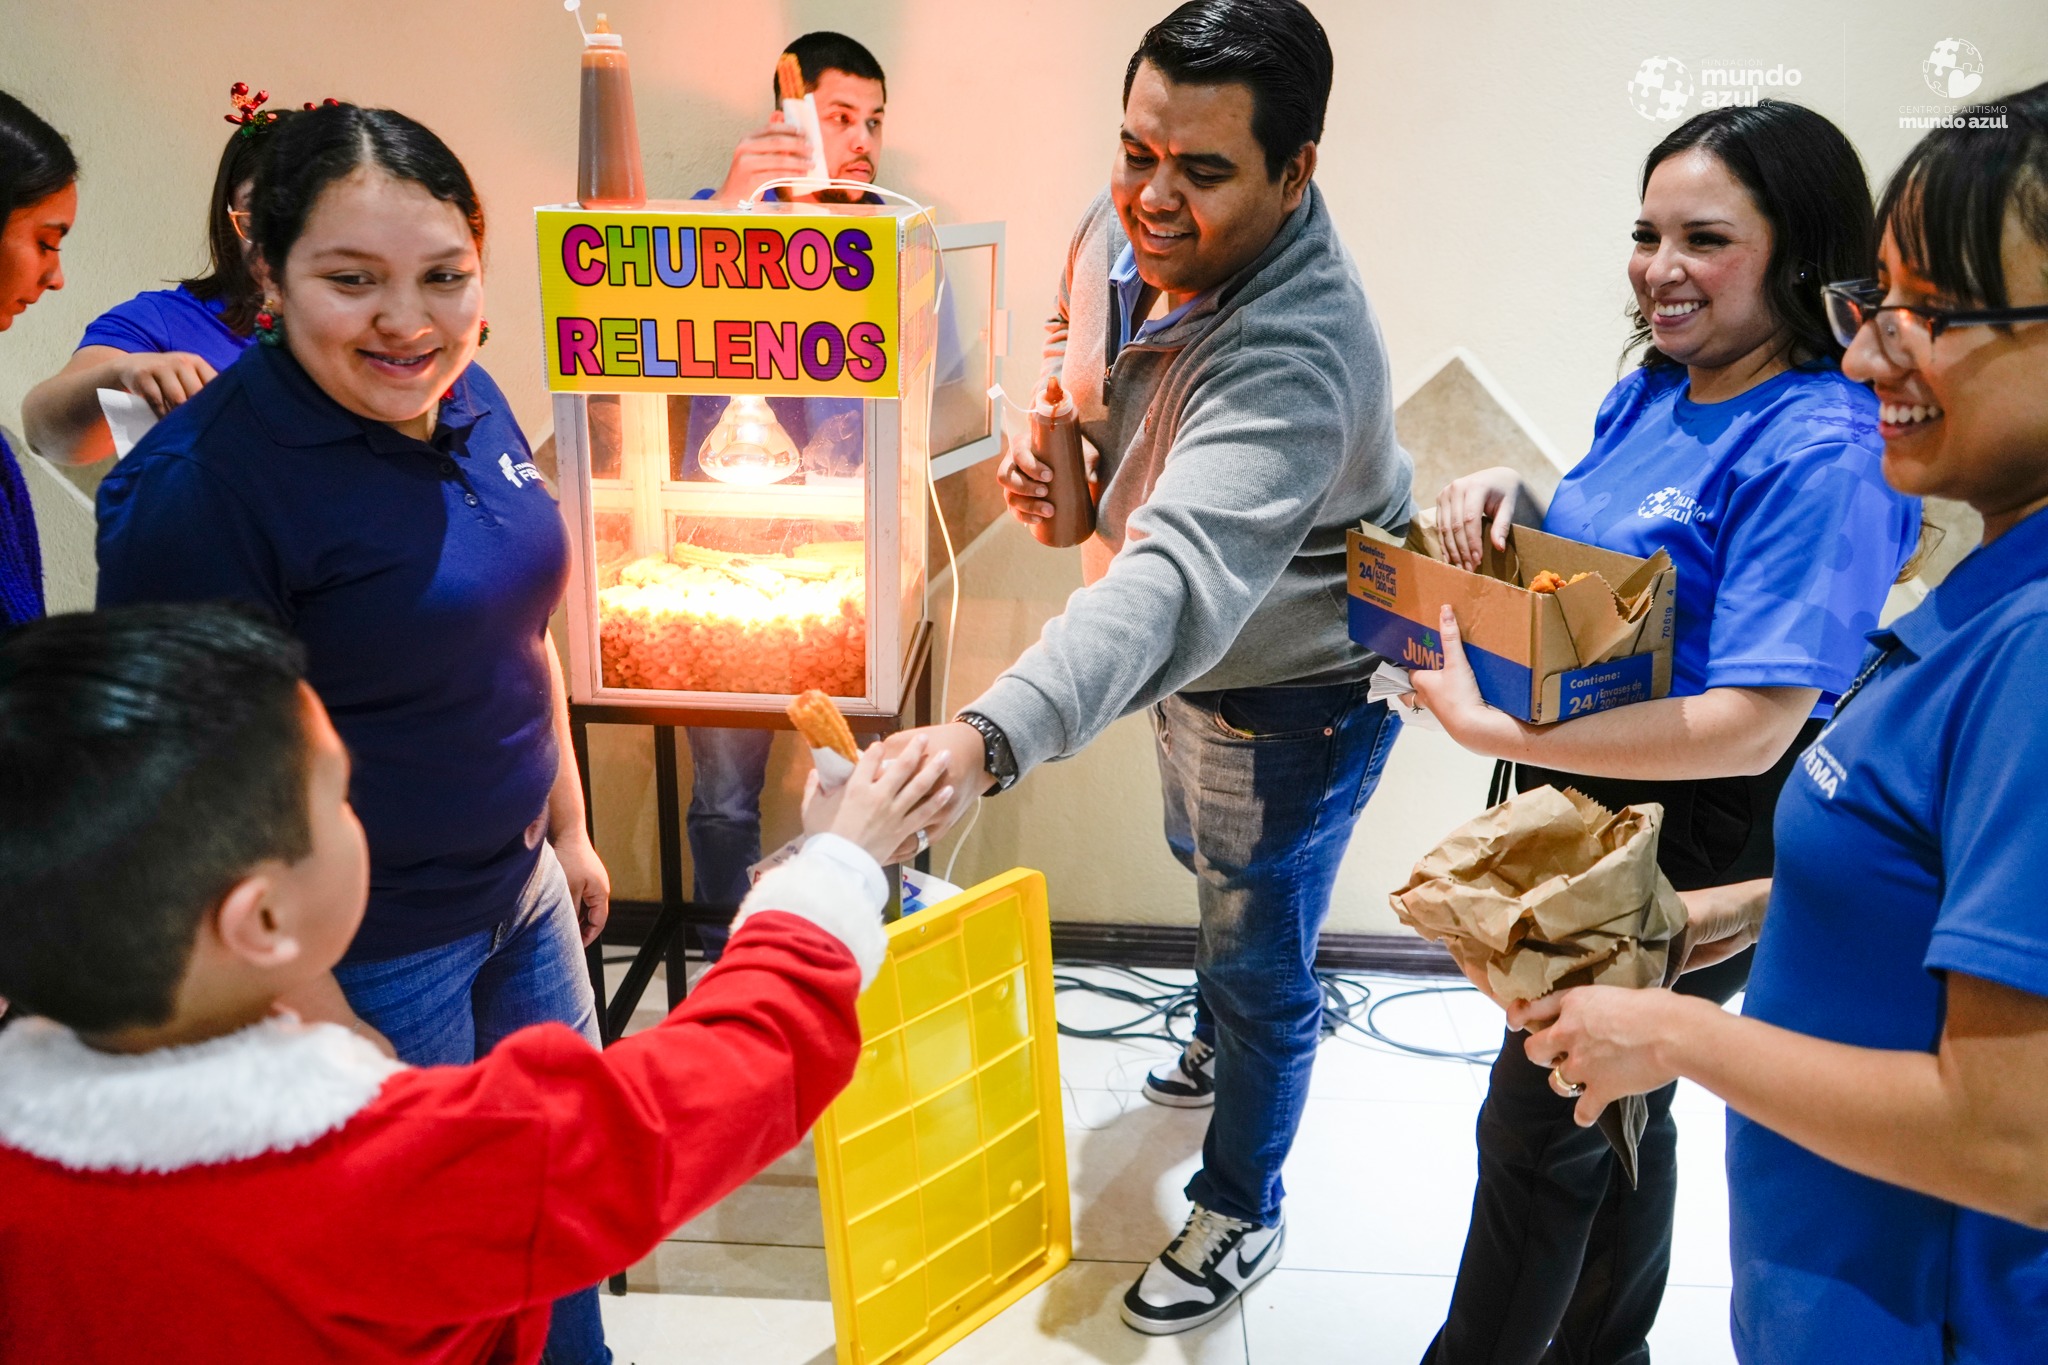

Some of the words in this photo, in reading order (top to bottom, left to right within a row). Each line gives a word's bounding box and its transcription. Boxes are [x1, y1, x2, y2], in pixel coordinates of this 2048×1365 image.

[561, 223, 875, 291] CHURROS
[556, 316, 887, 382] RELLENOS
[1403, 636, 1444, 670] JUME
[1570, 671, 1621, 689] Contiene:
[1600, 684, 1631, 698] Envases
[1632, 679, 1642, 691] de
